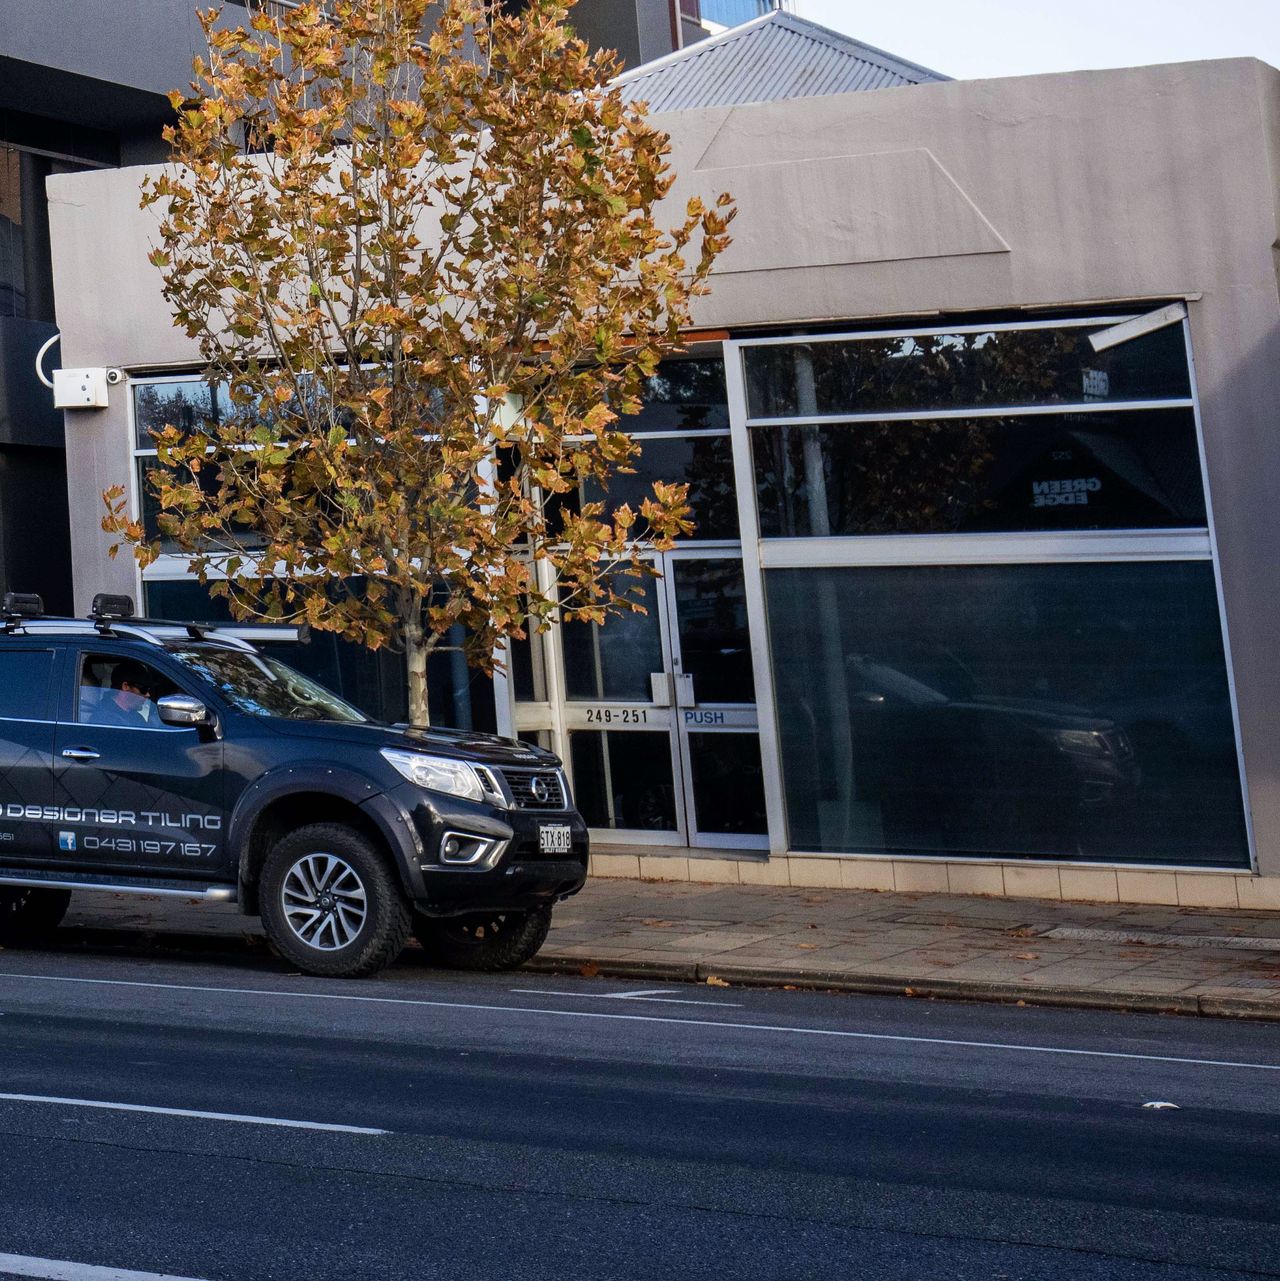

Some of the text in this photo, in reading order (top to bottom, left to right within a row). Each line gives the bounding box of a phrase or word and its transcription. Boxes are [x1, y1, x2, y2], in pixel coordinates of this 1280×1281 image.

[587, 710, 647, 724] 249-251
[684, 711, 724, 724] PUSH
[6, 804, 136, 825] DESIGNER
[141, 812, 221, 829] TILING
